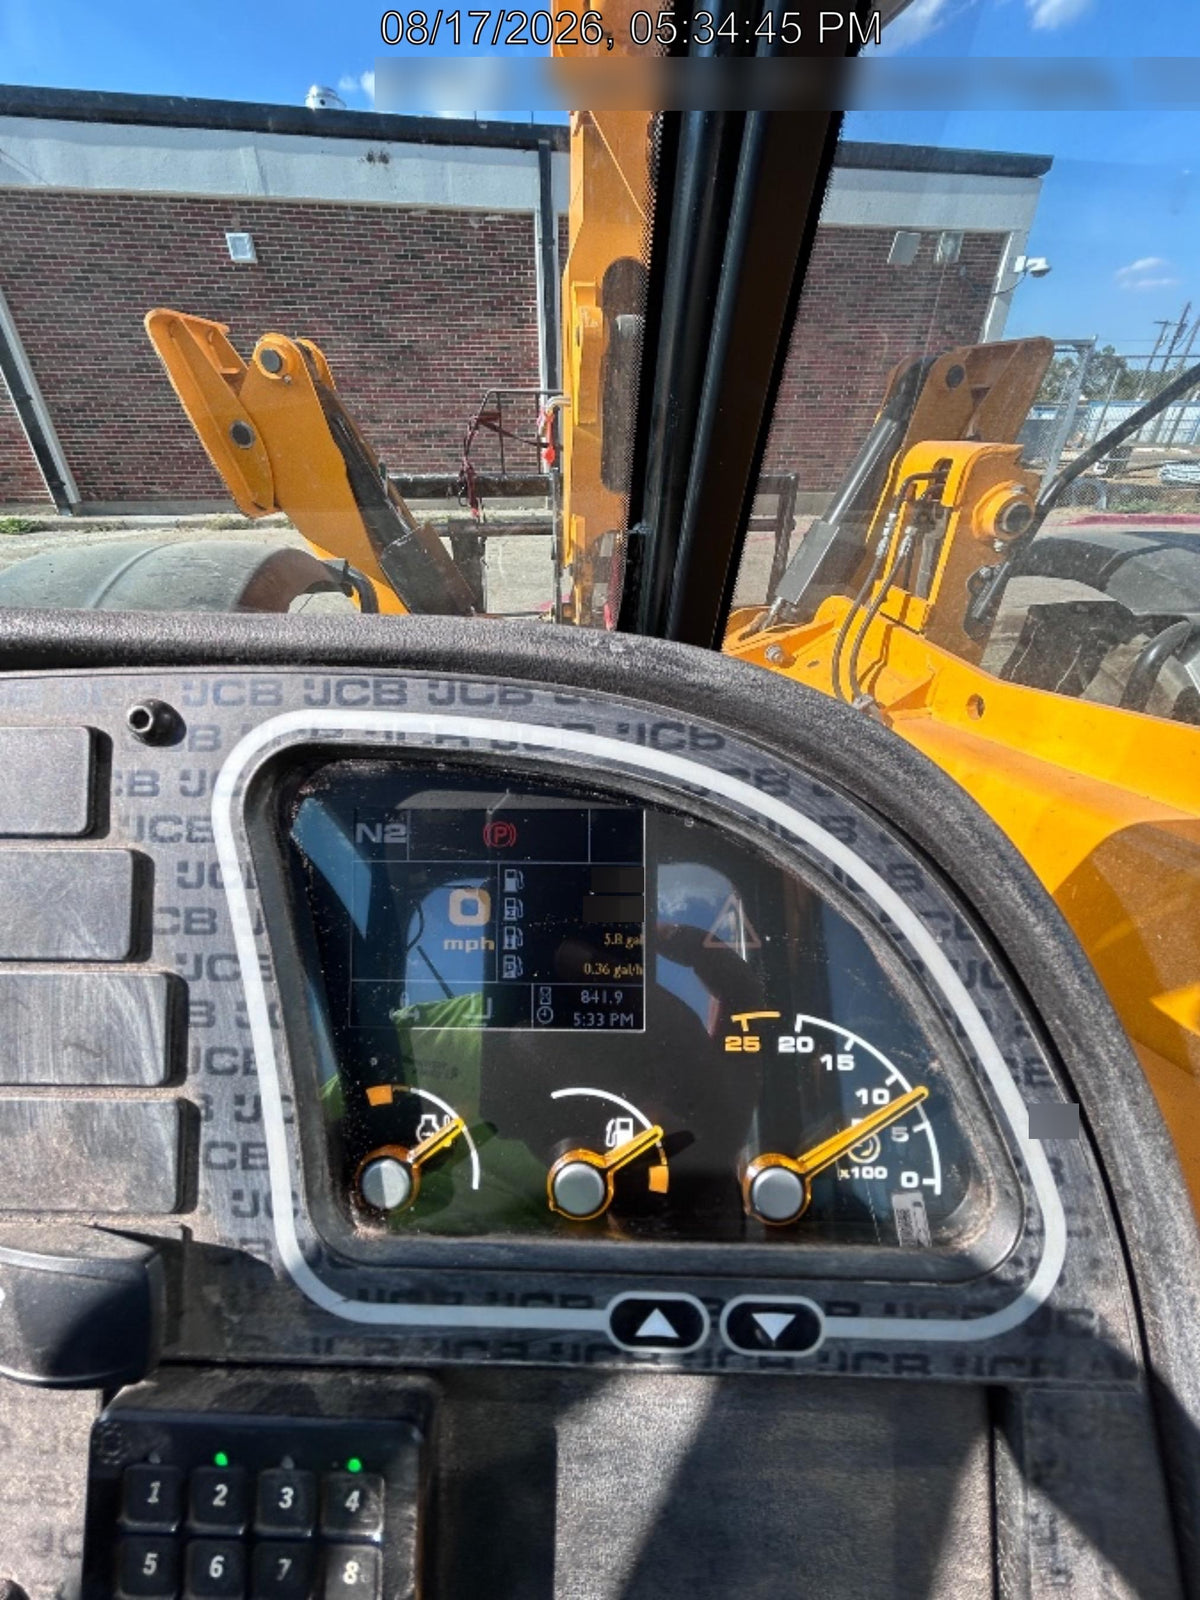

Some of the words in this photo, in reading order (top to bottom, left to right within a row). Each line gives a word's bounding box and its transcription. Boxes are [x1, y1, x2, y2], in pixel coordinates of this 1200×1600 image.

[303, 678, 407, 706] JCB
[355, 822, 407, 844] N2
[449, 888, 491, 927] 0
[443, 936, 495, 954] mph
[580, 989, 623, 1004] 841.9
[573, 1012, 605, 1027] 5:33
[609, 1012, 634, 1028] PM
[724, 1035, 761, 1053] 25
[777, 1035, 815, 1054] 20
[820, 1053, 856, 1072] 15
[855, 1087, 890, 1106] 10
[890, 1126, 909, 1143] 5
[839, 1165, 889, 1180] x100
[900, 1171, 919, 1189] 0
[146, 1480, 162, 1504] 1
[212, 1483, 229, 1507] 2
[278, 1486, 295, 1509] 3
[344, 1489, 361, 1513] 4
[142, 1552, 158, 1576] 5
[208, 1555, 225, 1579] 6
[276, 1558, 293, 1582] 7
[342, 1560, 361, 1585] 8
